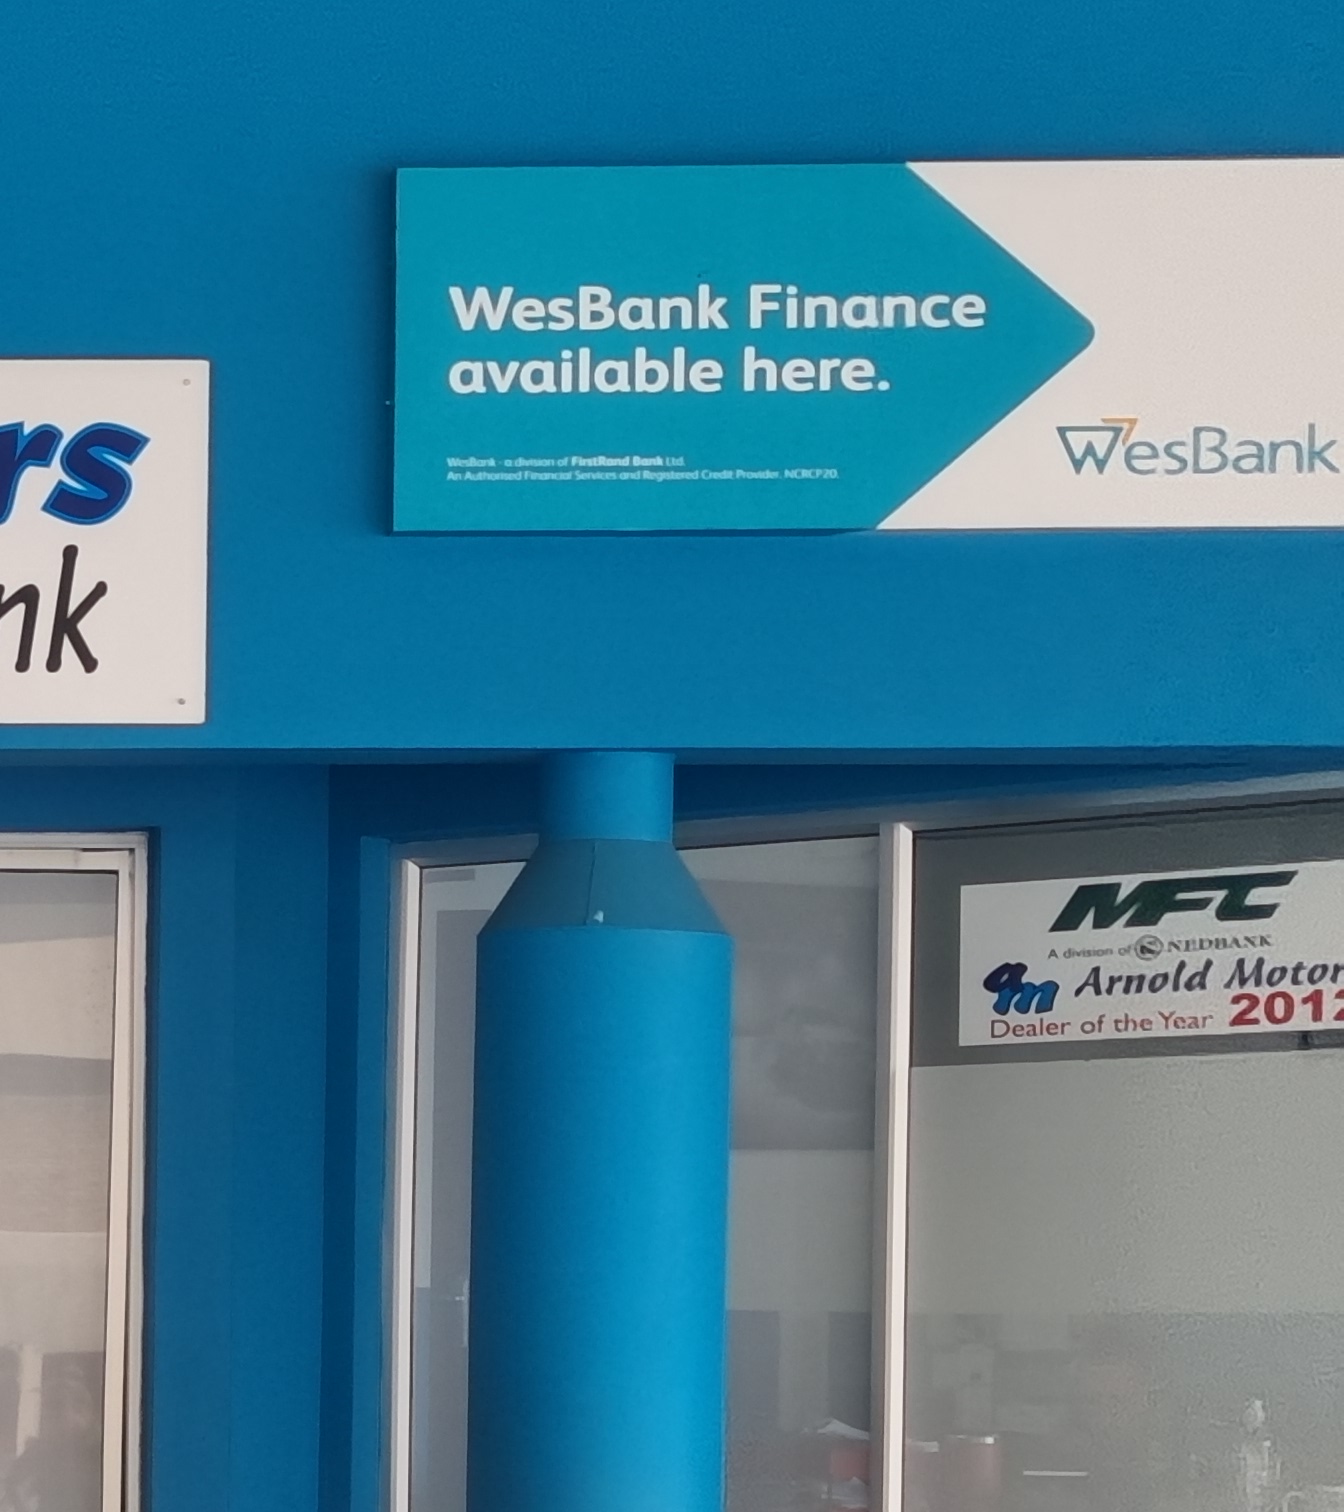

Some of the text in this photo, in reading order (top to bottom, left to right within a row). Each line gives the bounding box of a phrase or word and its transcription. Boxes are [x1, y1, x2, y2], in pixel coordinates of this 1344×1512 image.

[449, 283, 987, 331] WesBank Finance
[449, 346, 890, 393] available here.
[447, 457, 496, 468] WesBank
[515, 457, 556, 467] division
[557, 456, 569, 467] of
[571, 455, 629, 467] FirstRand
[633, 455, 663, 467] Bank
[1056, 418, 1340, 475] WesBank
[447, 471, 461, 481] An
[524, 470, 572, 481] Financial
[575, 470, 617, 480] Services
[619, 470, 640, 480] and
[643, 469, 699, 482] Registered
[701, 469, 733, 480] Credit
[1048, 870, 1299, 932] MFC
[1047, 949, 1058, 960] A
[1063, 946, 1113, 959] division
[1167, 934, 1272, 953] NEDBANK
[1074, 957, 1213, 998] Arnold
[990, 1016, 1071, 1039] Dealer
[1080, 1013, 1106, 1034] of
[1113, 1013, 1153, 1033] the
[1158, 1010, 1214, 1030] Year
